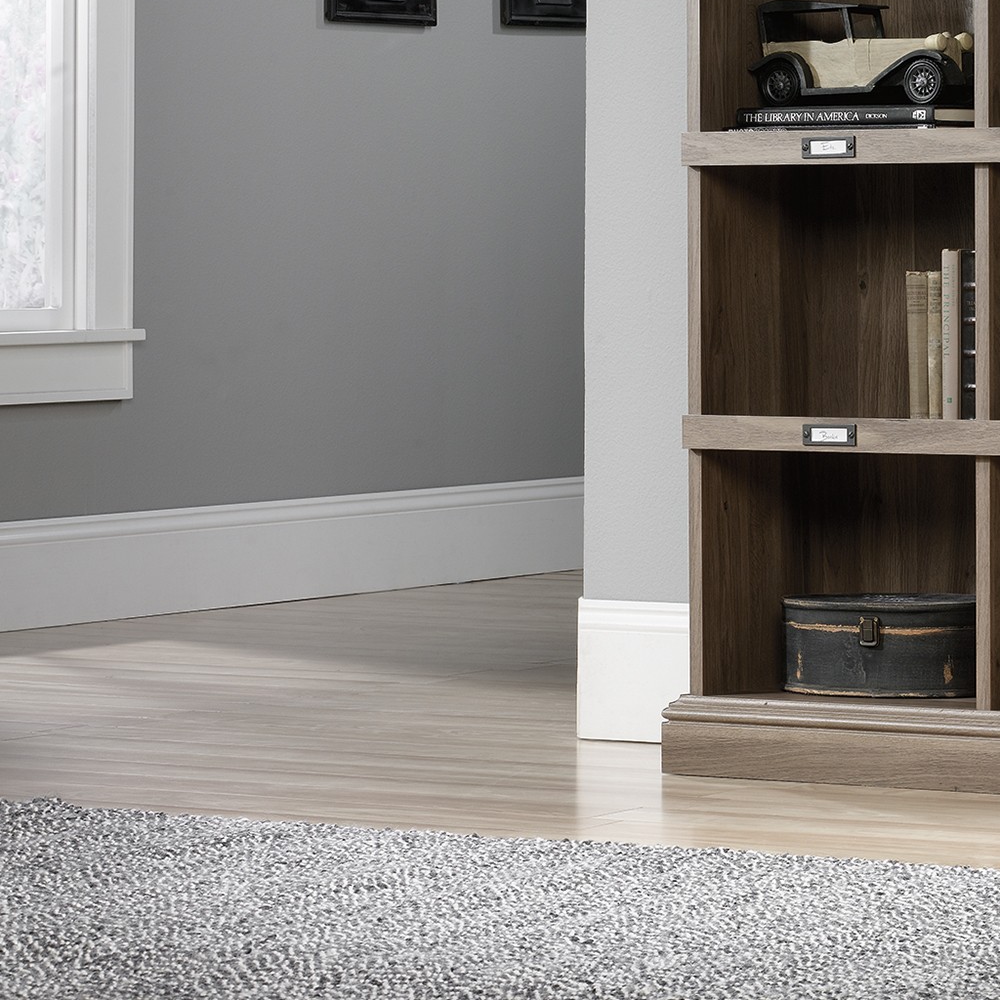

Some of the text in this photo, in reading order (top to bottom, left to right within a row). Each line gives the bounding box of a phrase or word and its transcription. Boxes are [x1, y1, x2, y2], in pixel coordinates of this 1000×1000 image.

[743, 112, 763, 123] THE
[764, 112, 803, 122] LIBRARY
[803, 112, 815, 122] IN
[815, 111, 860, 122] AMERICA
